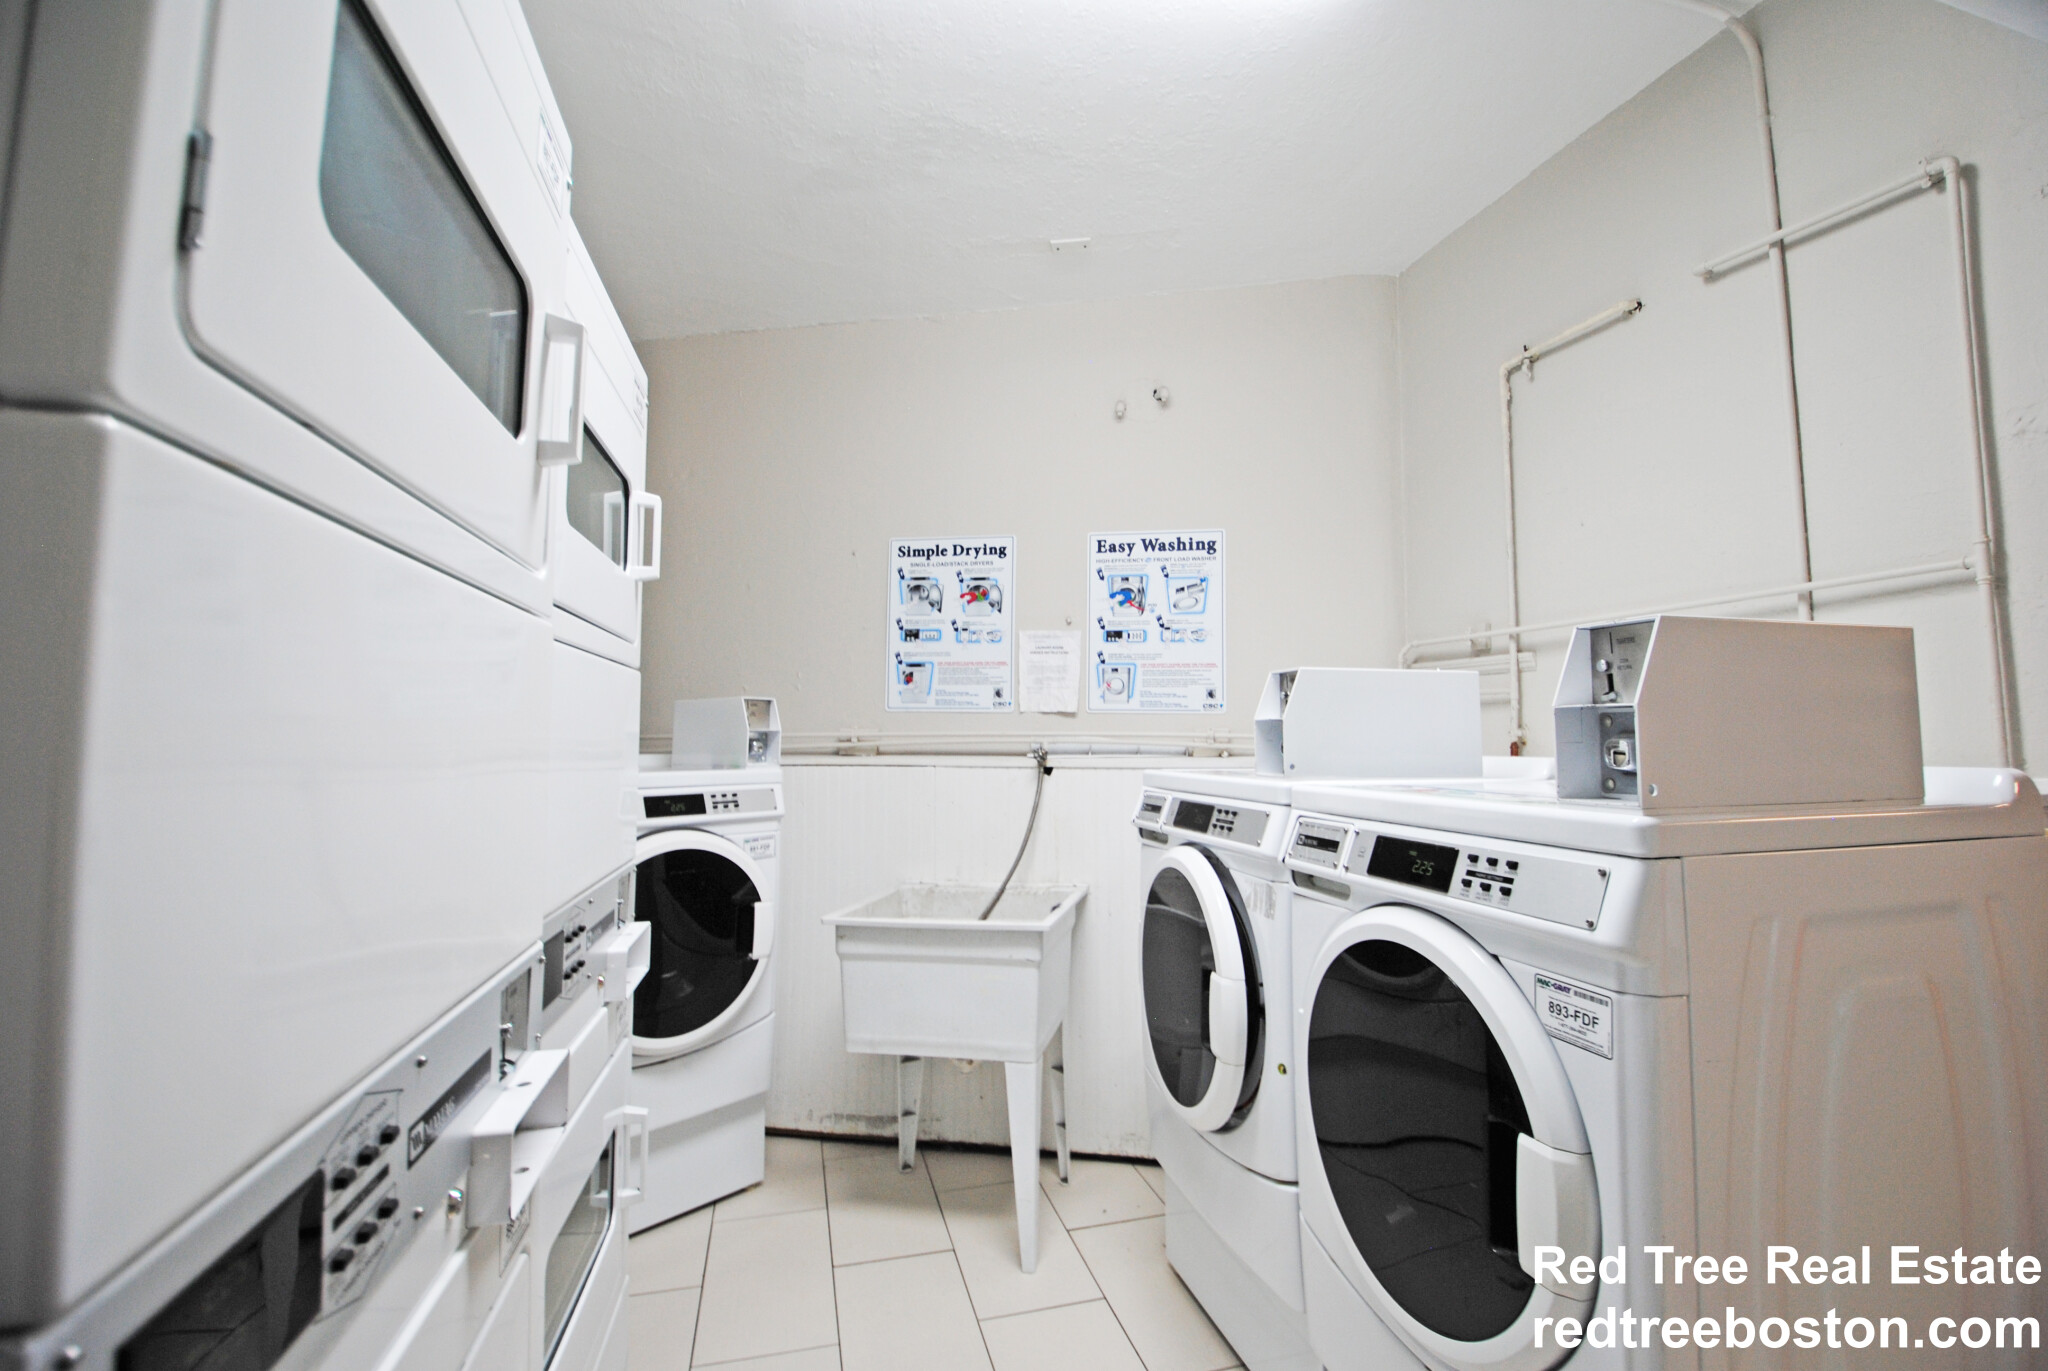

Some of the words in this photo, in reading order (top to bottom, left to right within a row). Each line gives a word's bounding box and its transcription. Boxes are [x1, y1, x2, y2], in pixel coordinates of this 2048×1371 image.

[898, 544, 948, 560] Simple
[952, 543, 1007, 559] Drying
[1096, 539, 1136, 557] Easy
[1140, 537, 1217, 555] Washing
[1548, 1000, 1600, 1029] 893-FDF
